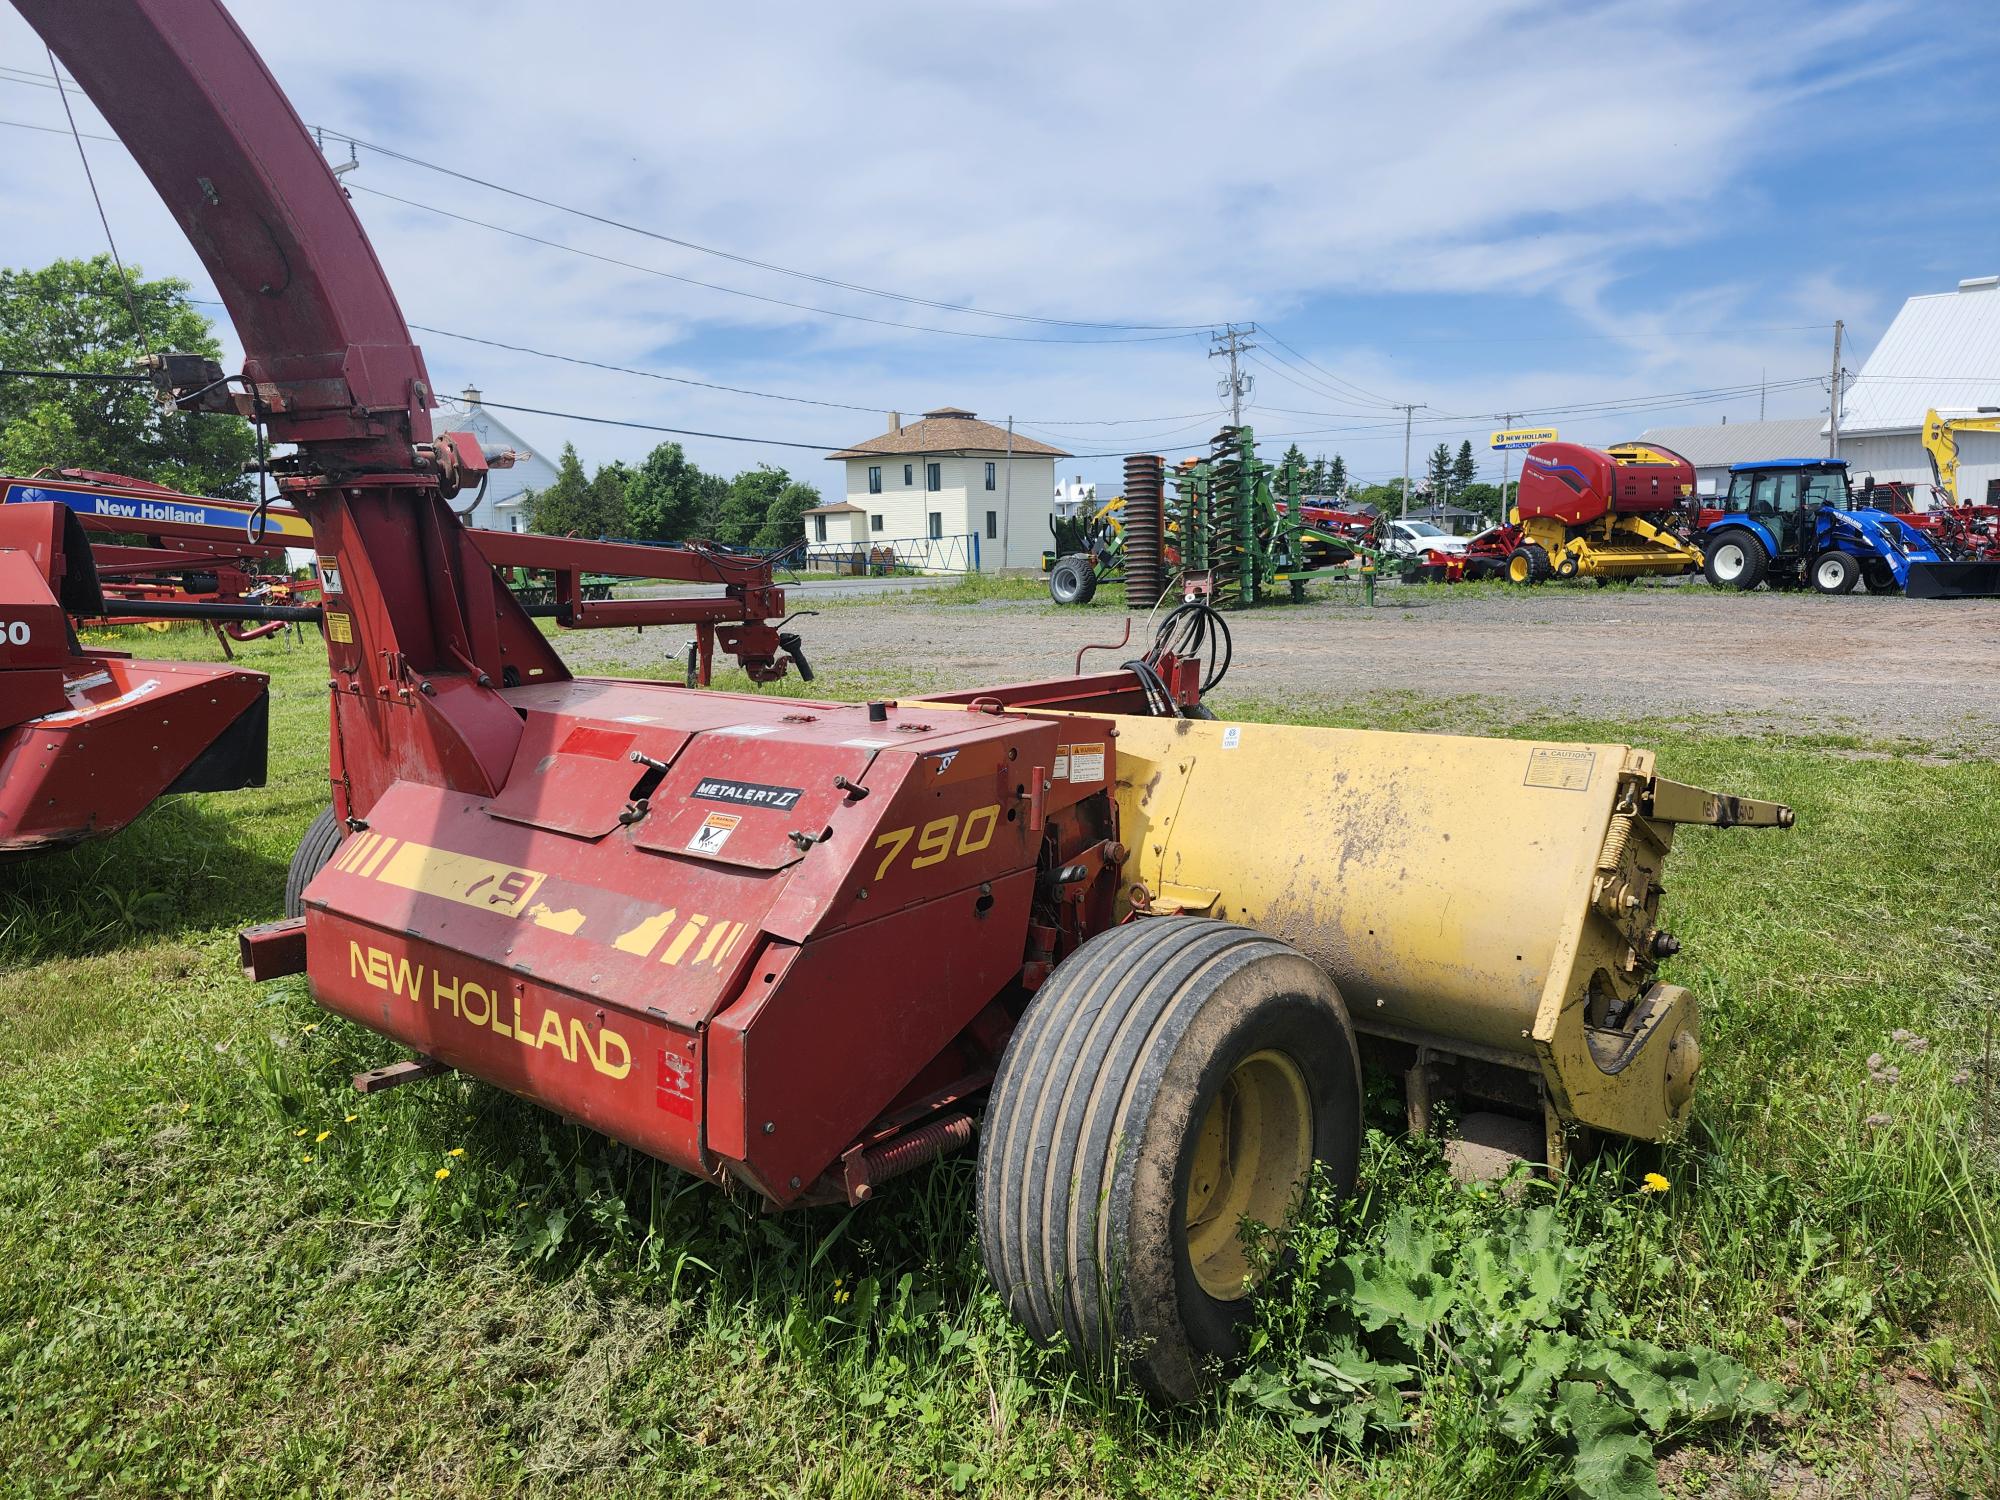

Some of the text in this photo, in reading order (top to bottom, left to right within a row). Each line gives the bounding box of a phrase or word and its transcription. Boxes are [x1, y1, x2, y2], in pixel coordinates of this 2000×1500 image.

[95, 498, 205, 524] New Holland
[1551, 750, 1587, 759] CAUTION
[697, 783, 778, 802] METALERT
[874, 804, 1001, 881] 790
[350, 940, 632, 1080] NEW HOLLAND
